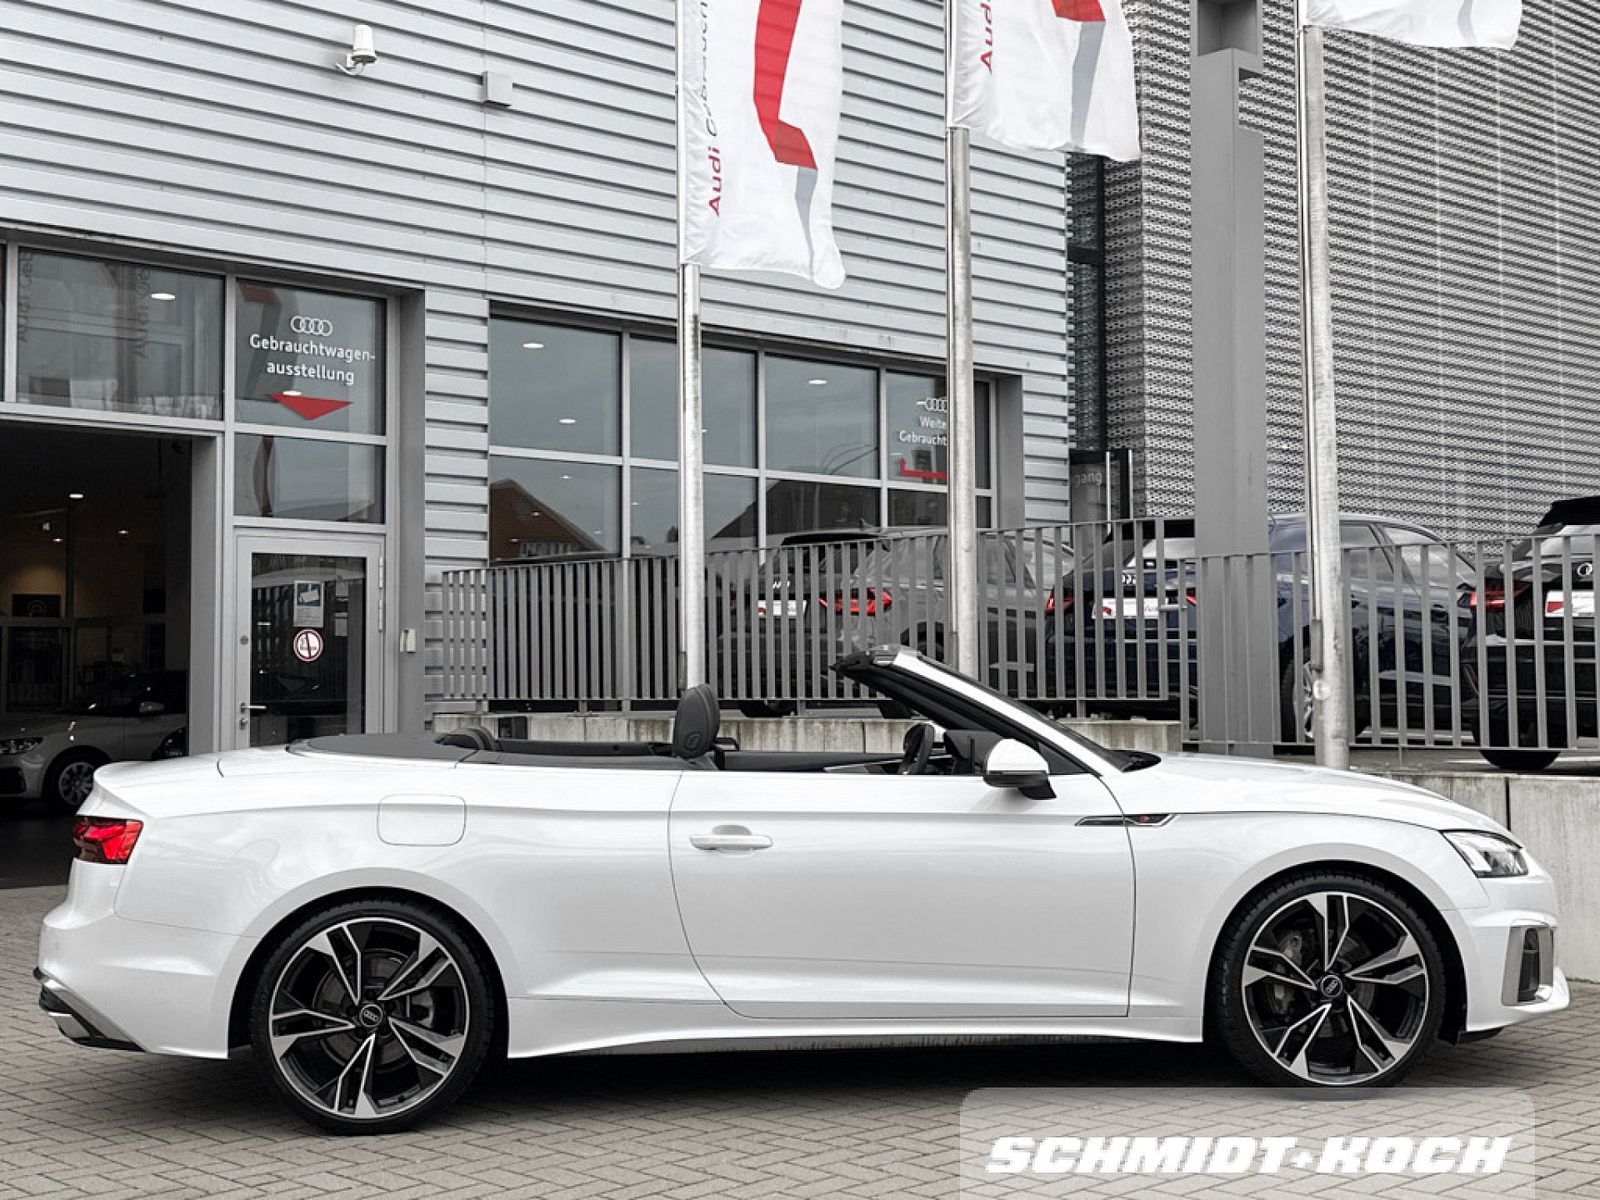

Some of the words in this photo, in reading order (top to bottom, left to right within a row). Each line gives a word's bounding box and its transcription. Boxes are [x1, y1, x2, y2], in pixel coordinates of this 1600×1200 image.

[980, 0, 993, 75] Aud
[708, 145, 722, 217] Audi
[249, 333, 376, 364] Gebrauchtwagen-
[266, 361, 355, 386] ausstellung
